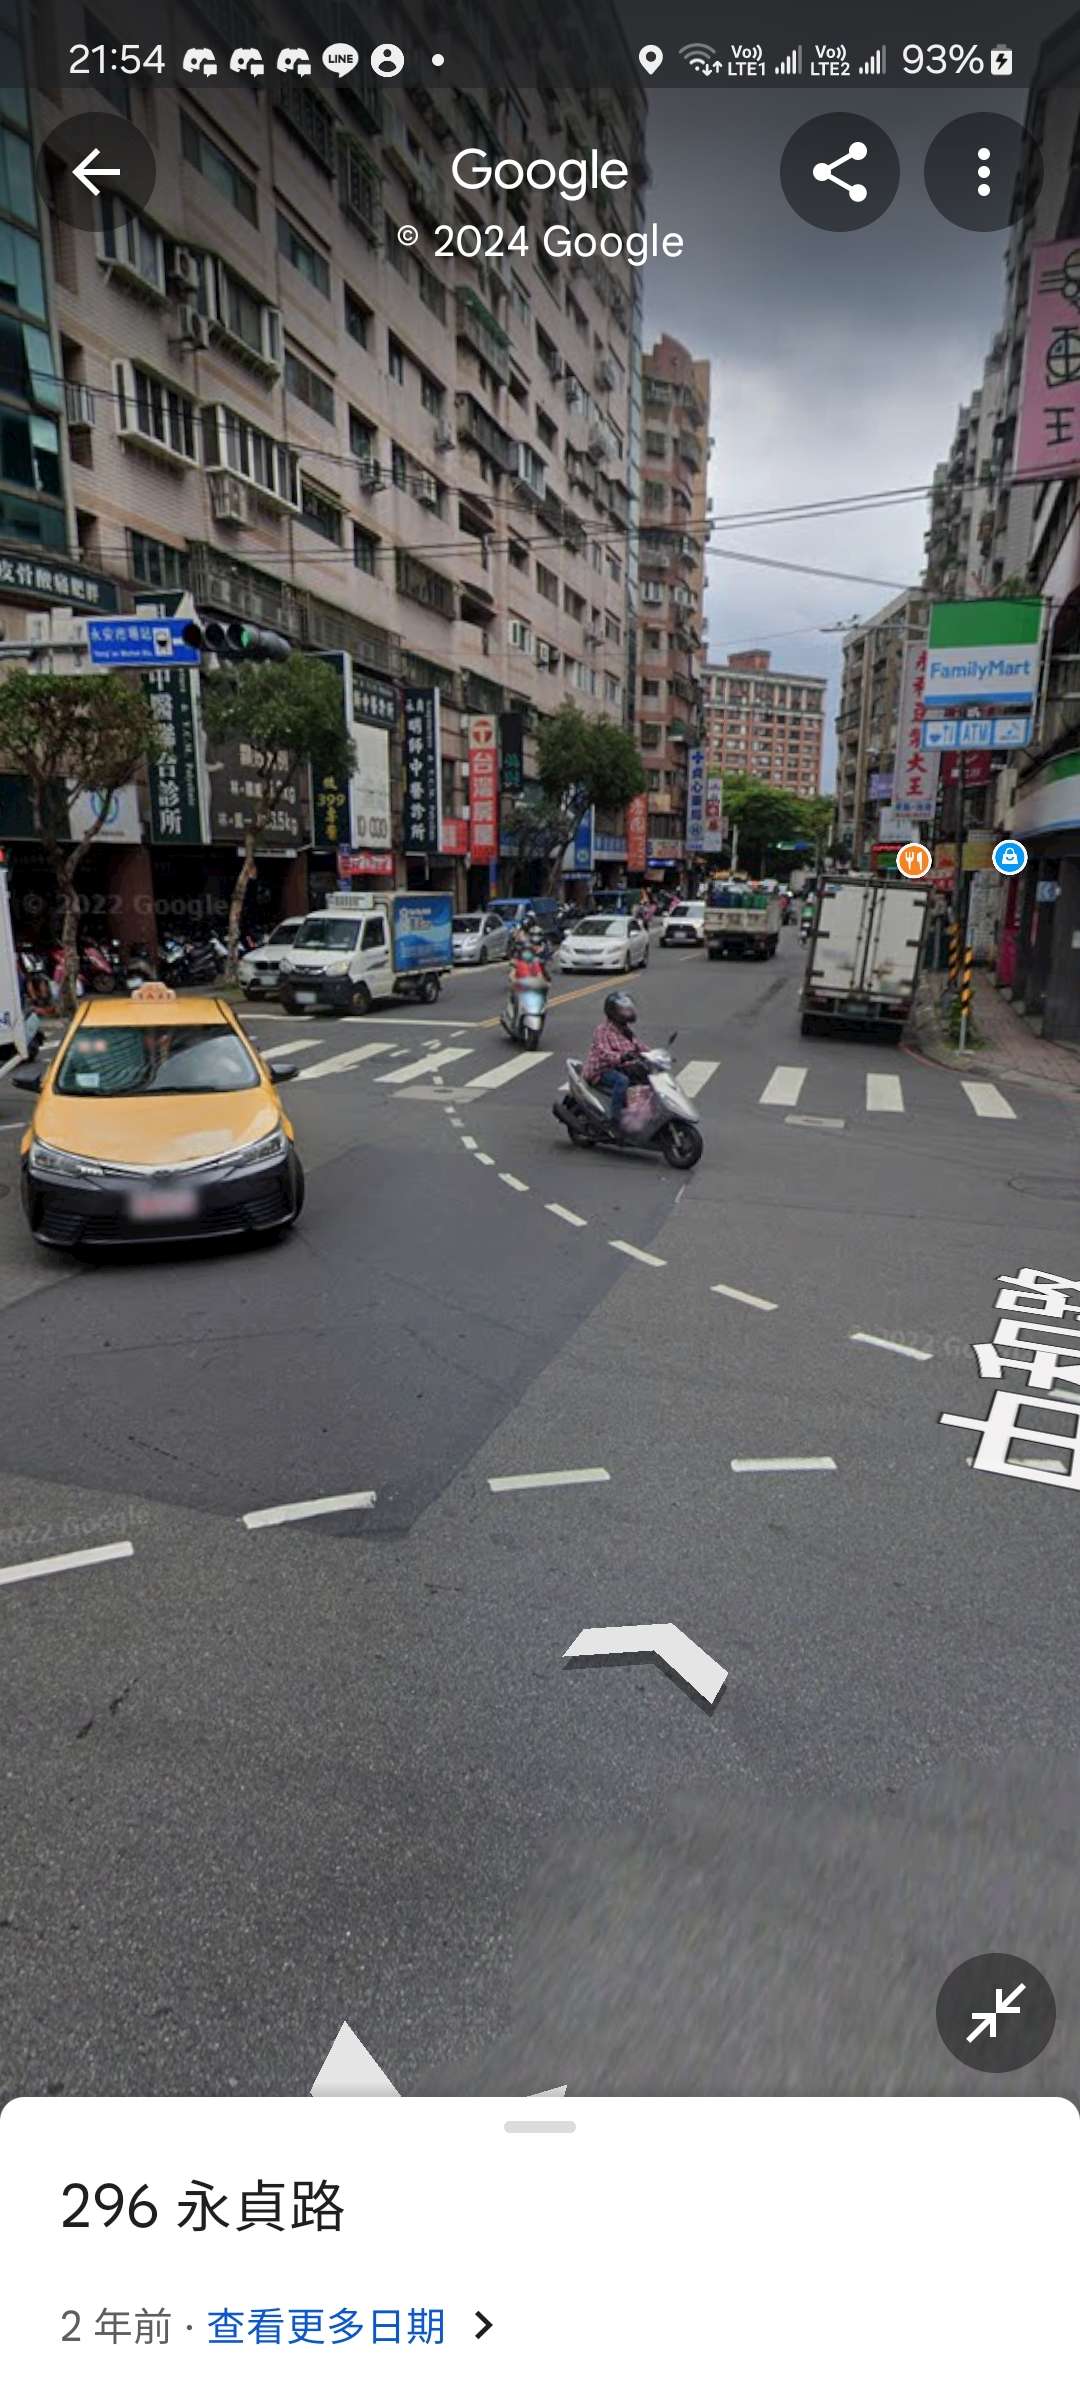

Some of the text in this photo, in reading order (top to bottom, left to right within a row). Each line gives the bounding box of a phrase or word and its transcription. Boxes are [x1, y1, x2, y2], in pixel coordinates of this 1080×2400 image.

[91, 625, 152, 642] 永安市場站
[930, 659, 1031, 680] FamilyMart
[962, 720, 990, 743] ATM
[318, 793, 345, 808] 399
